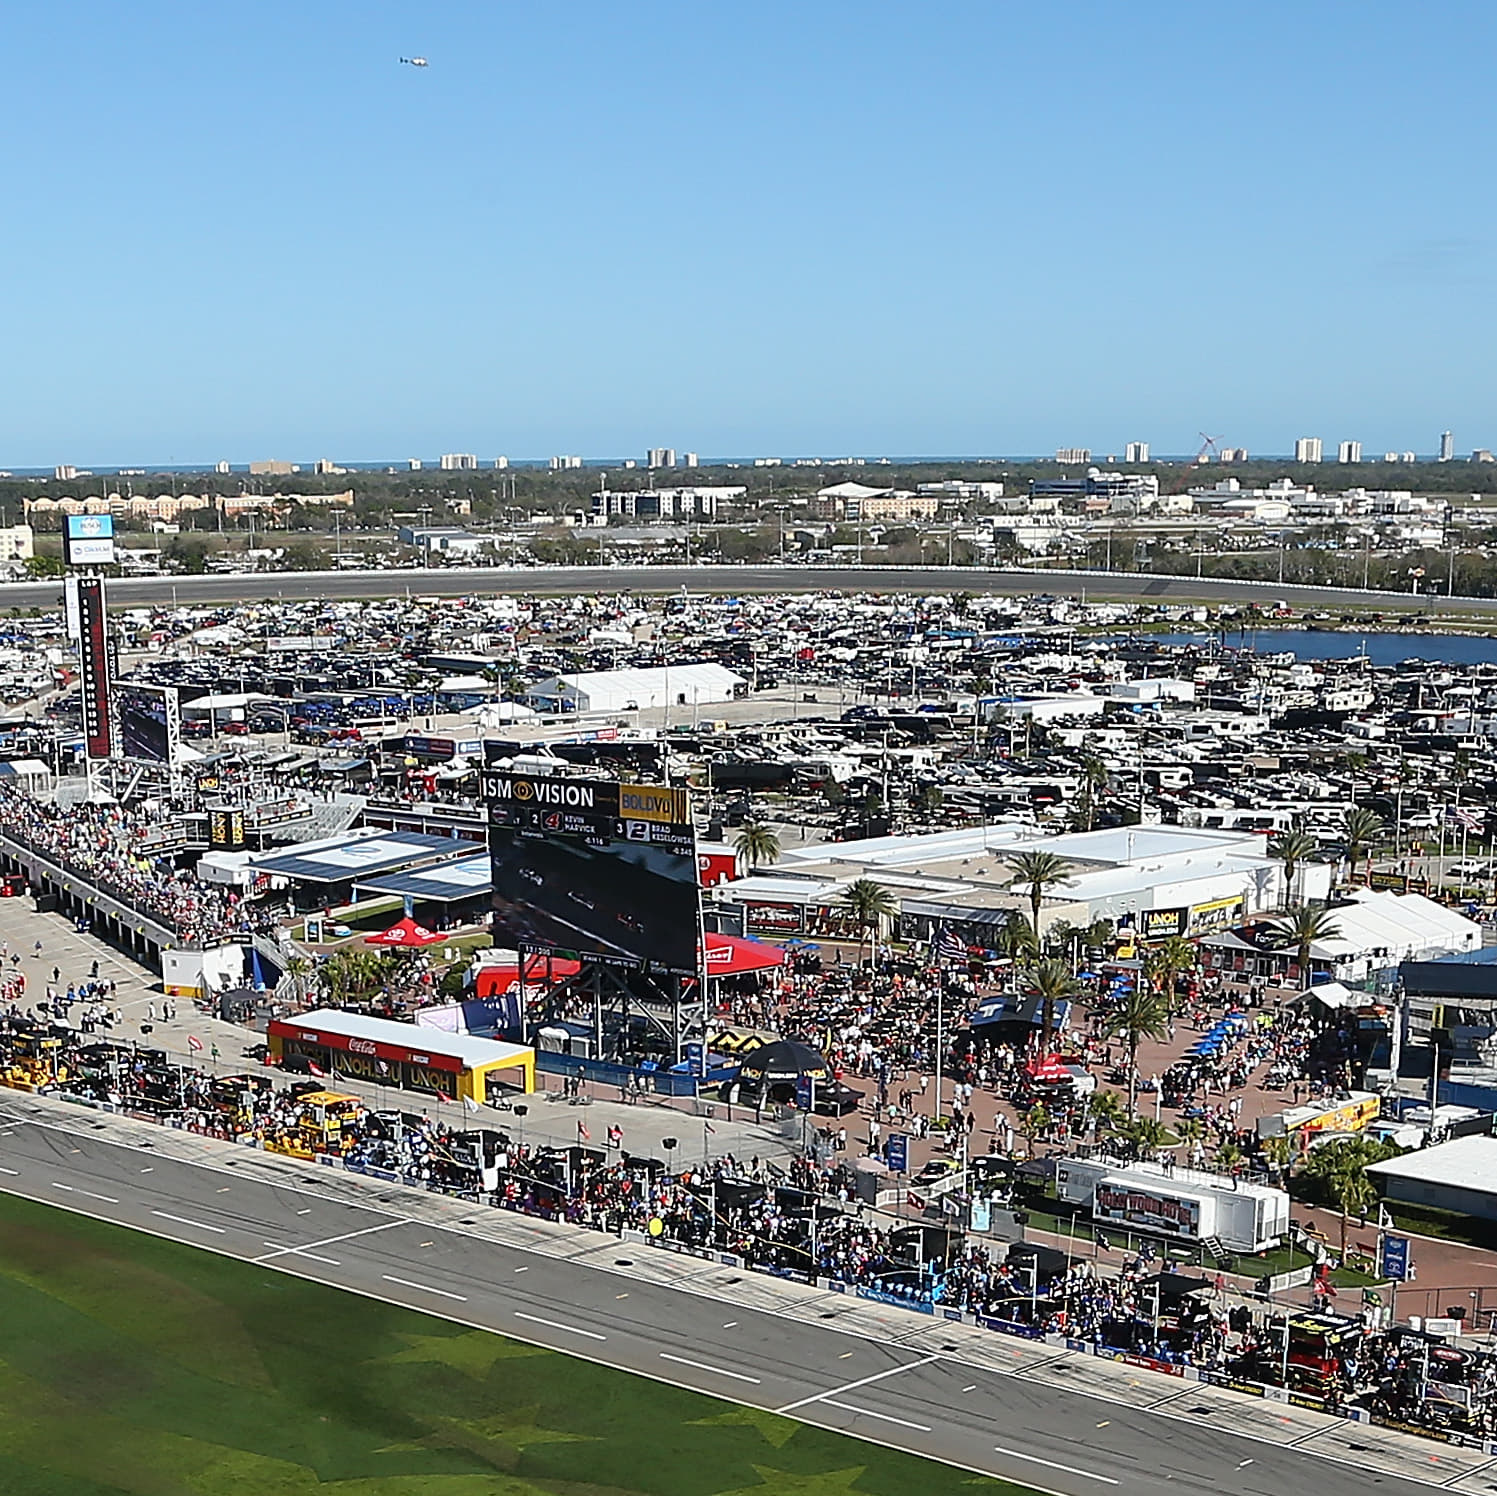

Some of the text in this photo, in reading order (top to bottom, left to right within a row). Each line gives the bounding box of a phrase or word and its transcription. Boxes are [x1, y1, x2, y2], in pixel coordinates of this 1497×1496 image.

[482, 777, 594, 807] ISM VISION
[545, 813, 560, 830] 4
[564, 815, 585, 825] KEVIN
[616, 823, 671, 840] 3 2 BRAD
[1148, 911, 1179, 926] UNOH
[410, 1067, 450, 1091] UNOH
